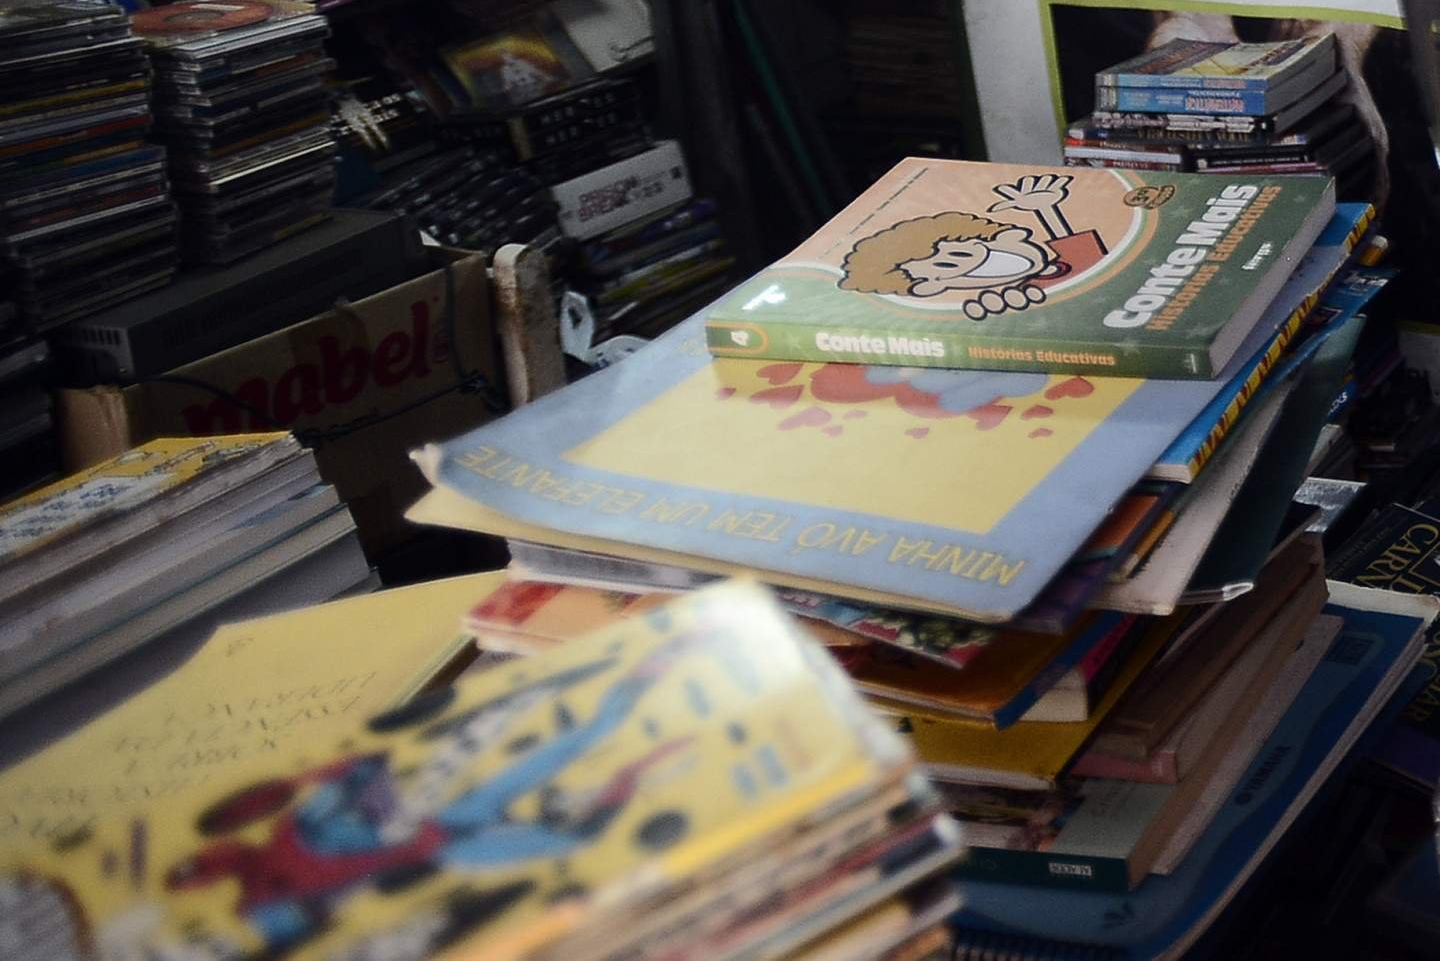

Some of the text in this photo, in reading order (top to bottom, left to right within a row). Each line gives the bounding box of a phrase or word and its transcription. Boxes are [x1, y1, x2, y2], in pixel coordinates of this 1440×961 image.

[1103, 247, 1207, 329] Conte
[1175, 184, 1260, 247] Mais
[183, 300, 432, 433] mabel
[815, 332, 885, 354] Conte
[889, 335, 946, 358] Mais
[1037, 350, 1117, 367] Educativas
[454, 444, 1028, 586] MINHA AVÓ TEM UM ELEFANTE
